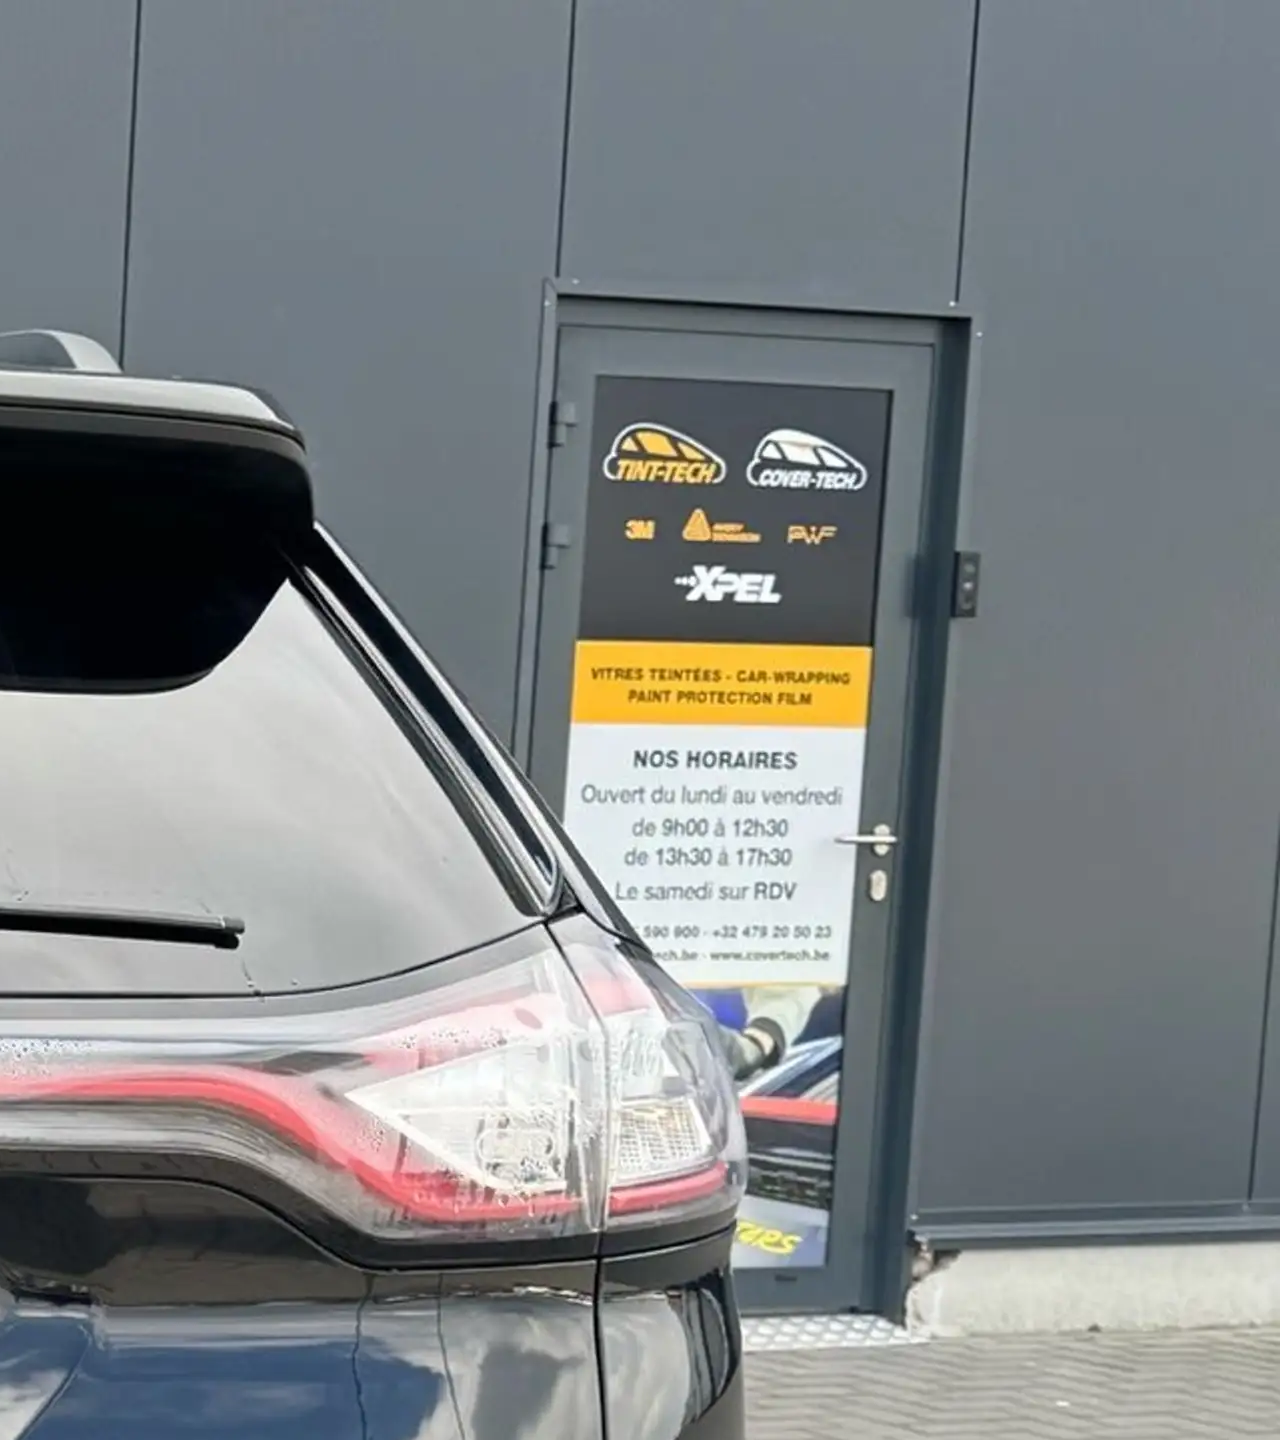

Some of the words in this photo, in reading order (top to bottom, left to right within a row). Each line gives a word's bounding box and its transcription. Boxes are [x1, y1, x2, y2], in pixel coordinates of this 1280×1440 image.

[616, 459, 717, 484] TINT-TECH
[758, 469, 858, 489] COVER-TECH
[625, 520, 655, 540] 3M
[685, 565, 782, 603] XPEL
[591, 668, 644, 681] VITRES
[649, 667, 722, 683] TEINTÉES
[736, 670, 851, 685] CAR-WRAPPING
[628, 689, 671, 703] PAINT
[676, 690, 773, 705] PROTECTION
[777, 692, 812, 705] FILM
[634, 749, 679, 769] NOS
[686, 751, 798, 770] HORAIRES
[581, 784, 645, 804] Ouvert
[651, 785, 675, 805] du
[681, 786, 727, 805] lundi
[732, 790, 756, 805] au
[761, 787, 844, 806] vendredi
[632, 818, 656, 837] de
[661, 818, 709, 837] 9h00
[733, 819, 789, 837] 12h30
[624, 848, 648, 866] de
[656, 848, 712, 866] 13h30
[737, 848, 793, 866] 17h30
[615, 882, 638, 900] Le
[644, 882, 713, 900] samedi
[719, 885, 750, 900] sur
[754, 882, 798, 900] RDV
[712, 925, 738, 938] +32
